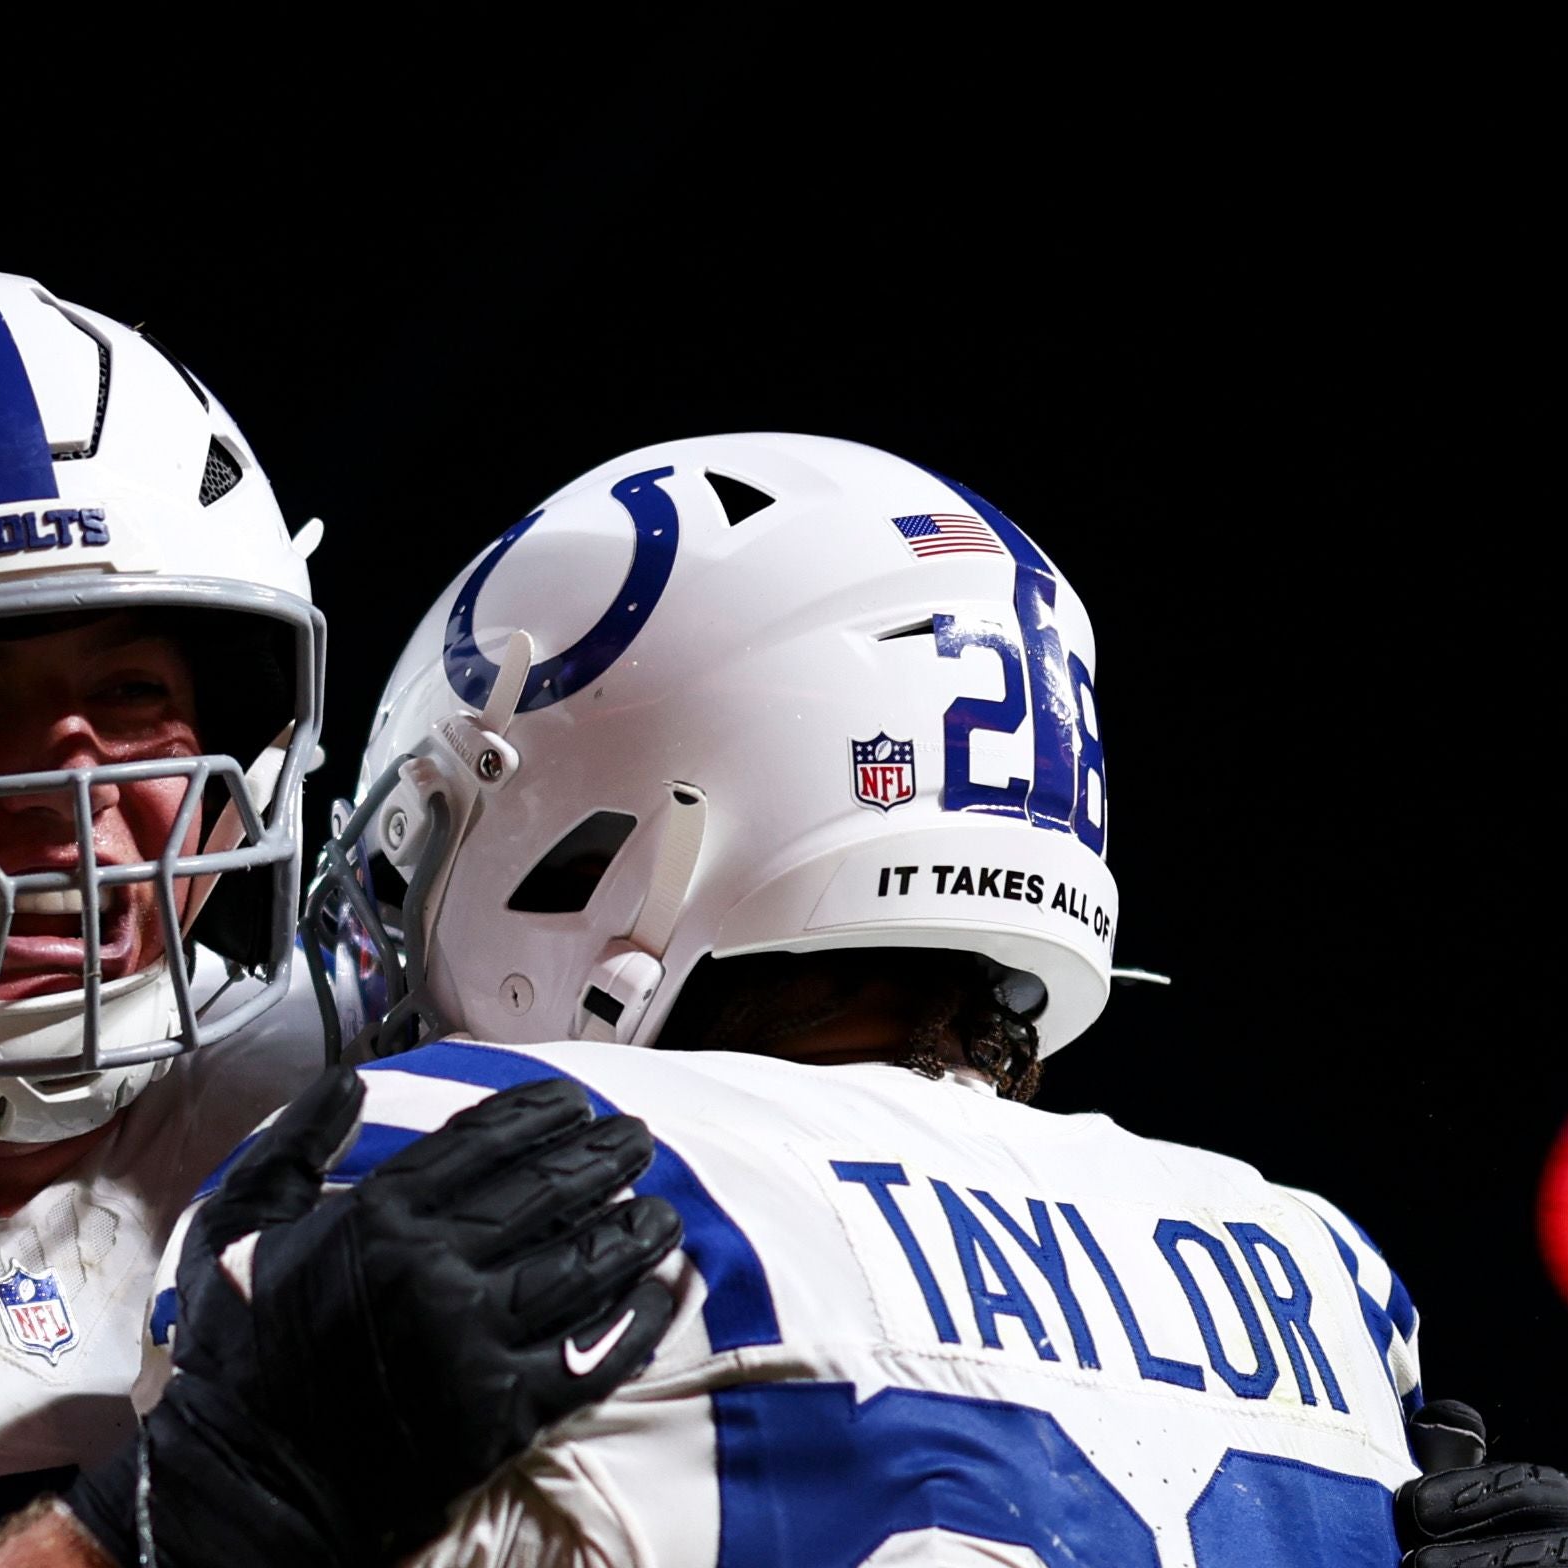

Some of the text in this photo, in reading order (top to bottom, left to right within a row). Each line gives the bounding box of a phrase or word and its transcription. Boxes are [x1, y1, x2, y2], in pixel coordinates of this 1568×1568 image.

[932, 613, 1107, 858] 28
[860, 766, 911, 803] NFL
[877, 866, 918, 897] IT
[931, 865, 1045, 905] TAKES
[1051, 882, 1089, 926] ALL
[1094, 905, 1110, 943] OF
[10, 1303, 69, 1342] NFL
[829, 1159, 1350, 1416] TAYLOR
